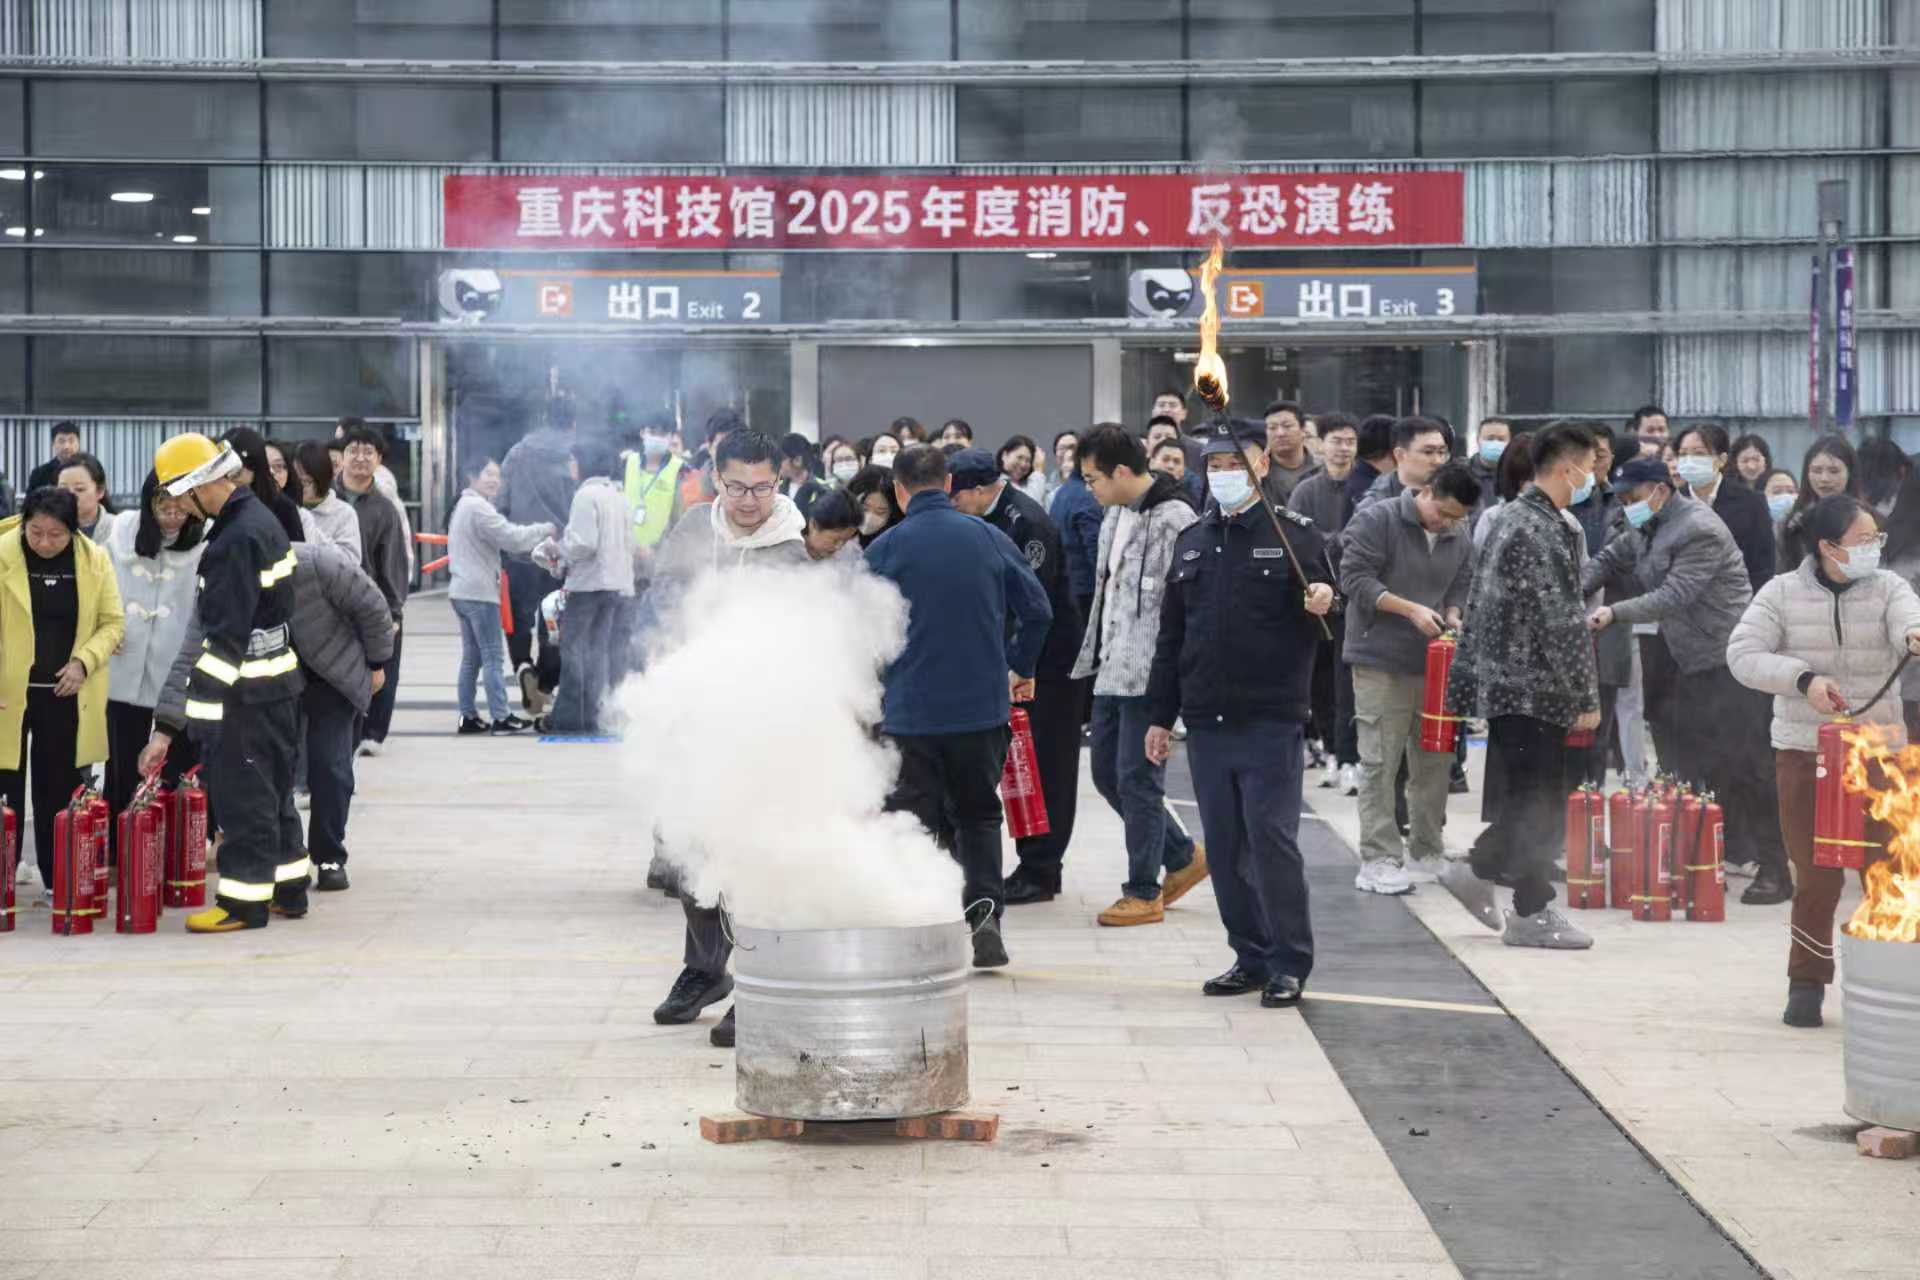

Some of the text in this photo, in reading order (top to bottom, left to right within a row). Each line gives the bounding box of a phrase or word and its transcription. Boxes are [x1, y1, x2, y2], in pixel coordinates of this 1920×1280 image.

[516, 184, 1395, 238] 重庆科技馆2025年度消防、反恐演练
[608, 282, 761, 320] 出口 Exit 2
[1298, 280, 1455, 319] 出口 Exit 3
